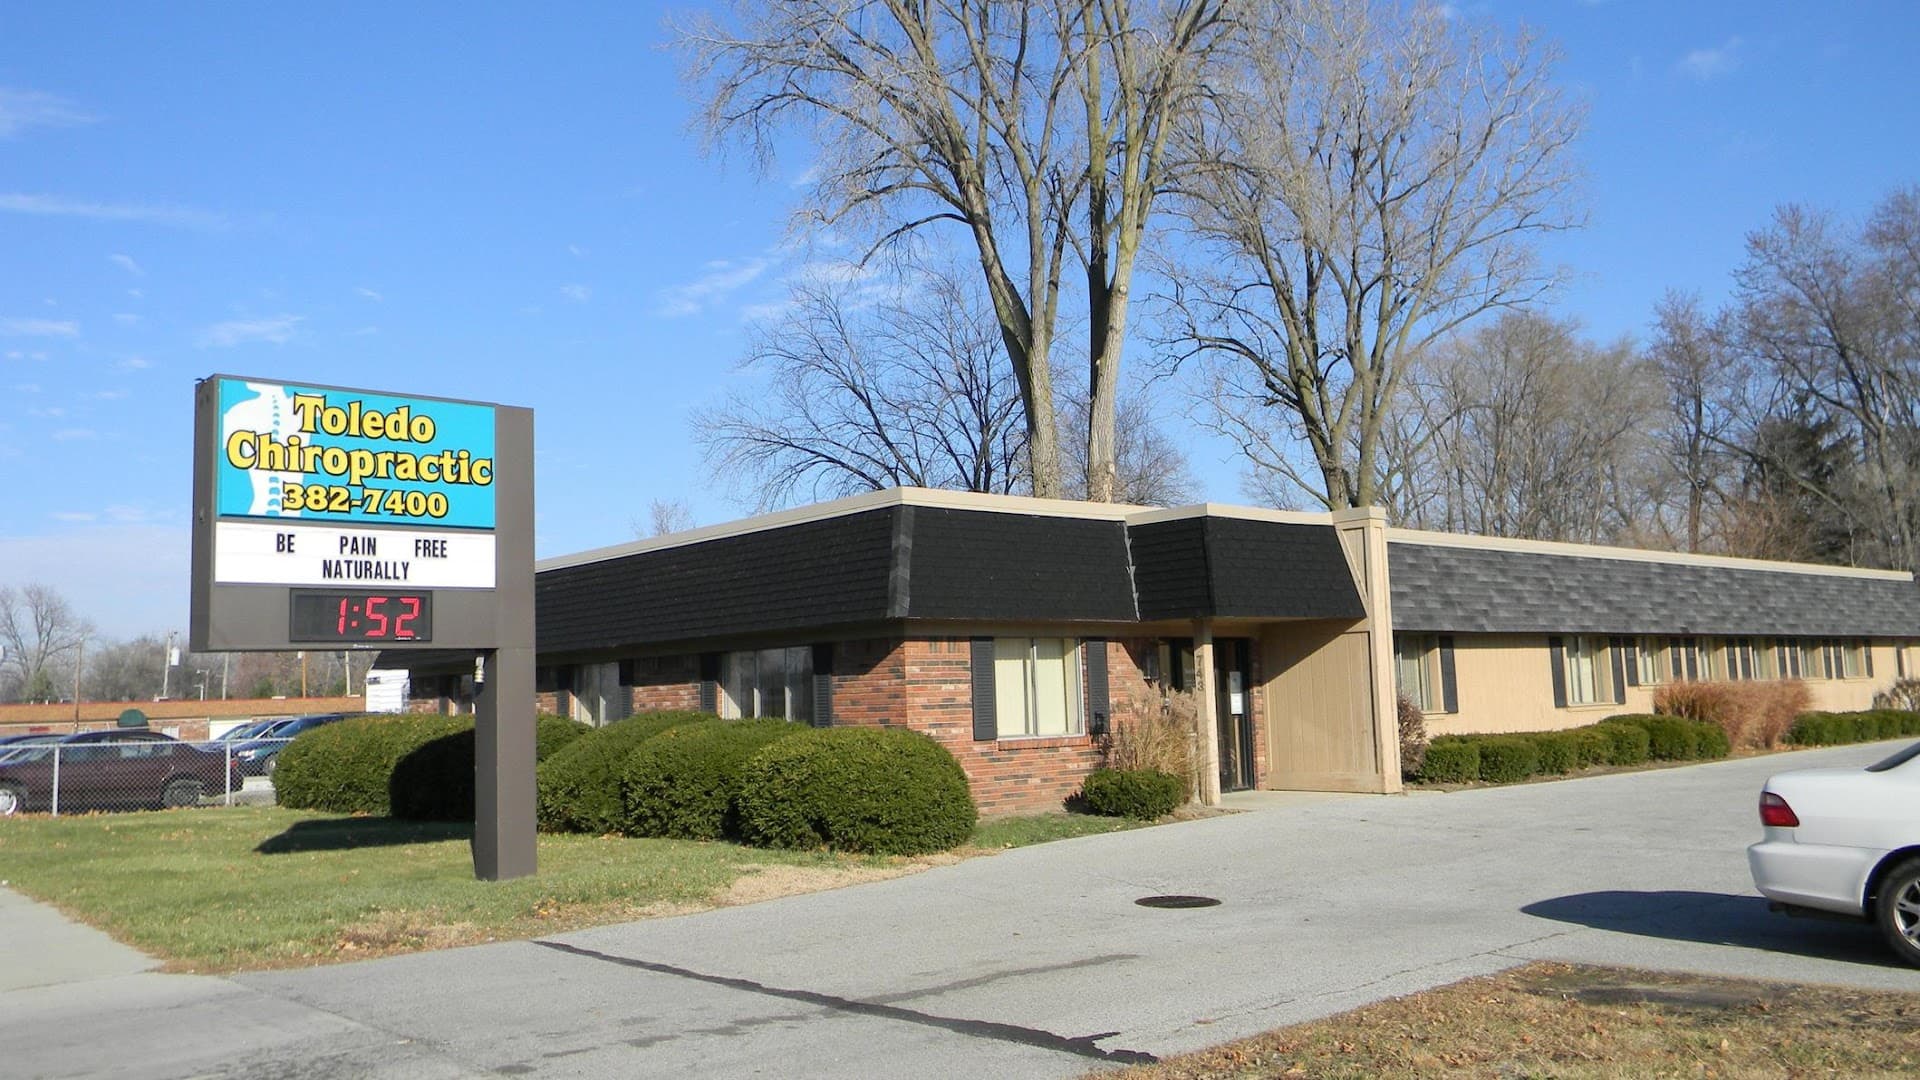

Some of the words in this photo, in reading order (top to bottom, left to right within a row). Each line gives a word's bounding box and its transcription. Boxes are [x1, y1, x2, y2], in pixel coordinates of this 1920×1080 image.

[294, 393, 436, 443] Toledo
[227, 430, 493, 485] Chiropractic
[283, 482, 449, 518] 382-7400
[276, 533, 295, 553] BE
[339, 535, 377, 556] PAIN
[414, 538, 448, 558] FREE
[322, 559, 410, 580] NATURALLY
[338, 597, 420, 637] 1:52
